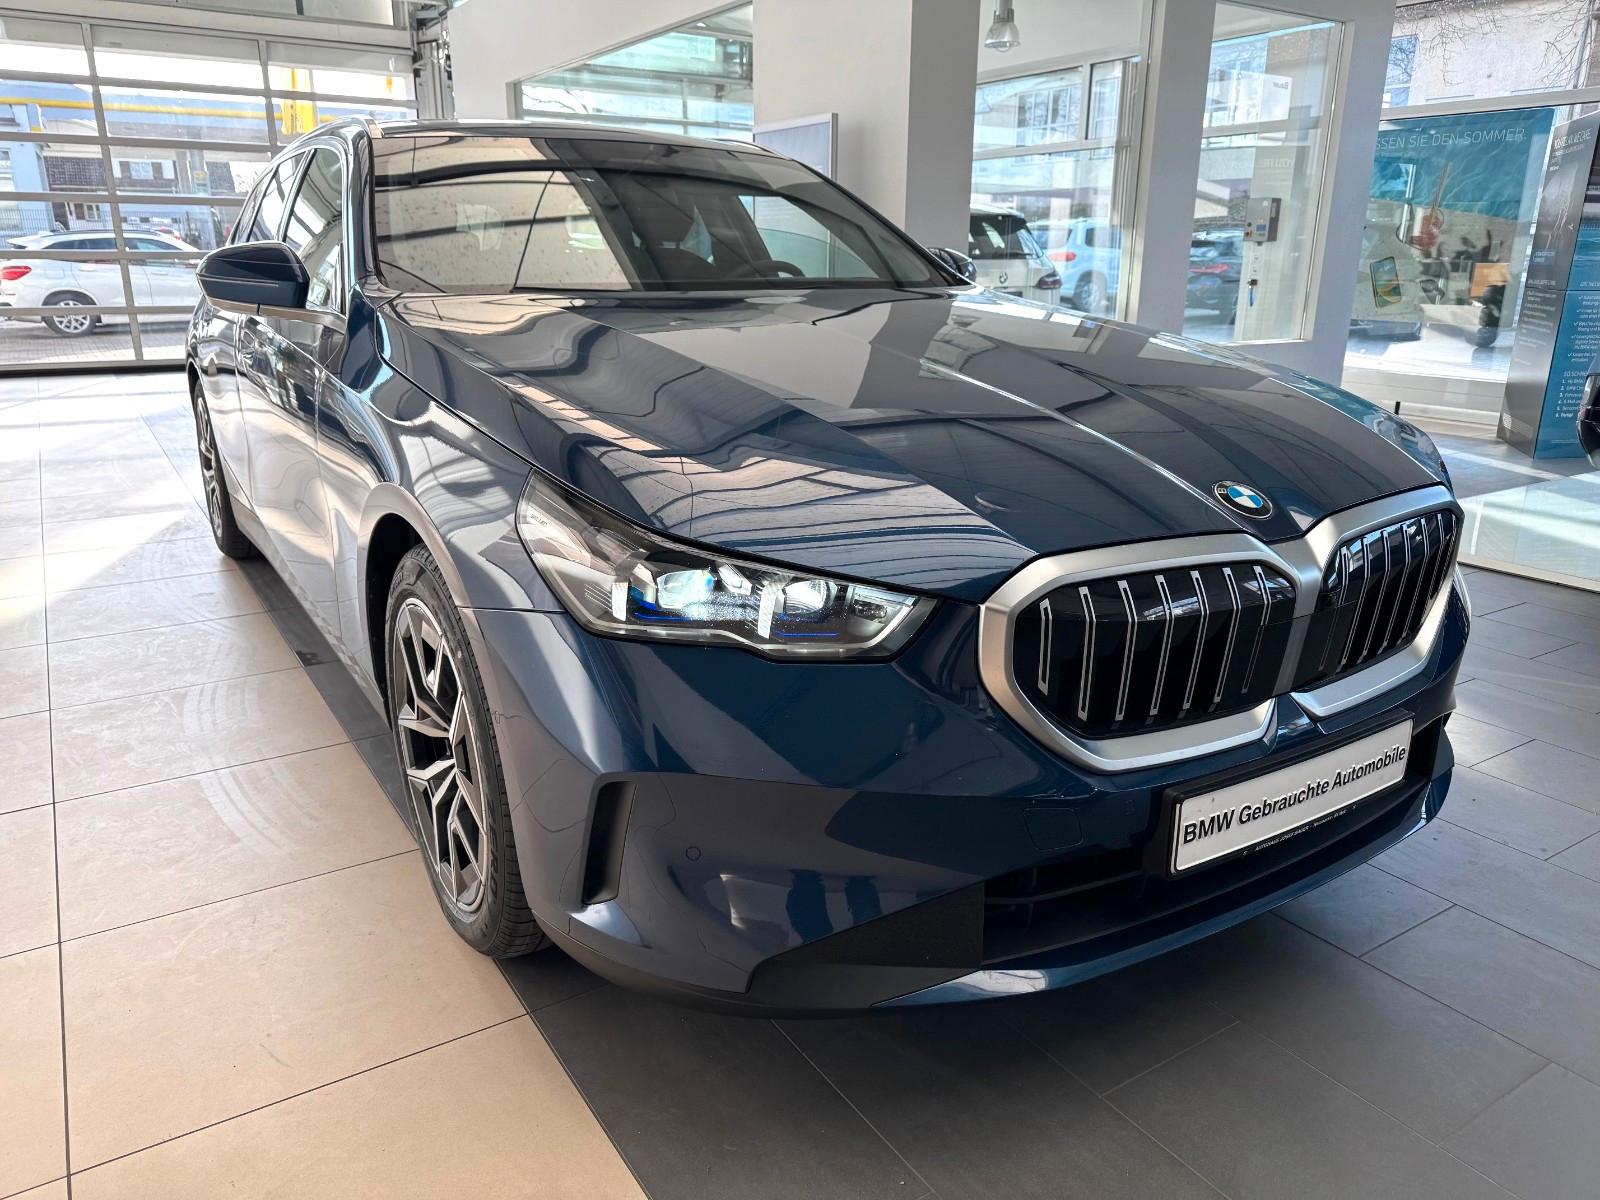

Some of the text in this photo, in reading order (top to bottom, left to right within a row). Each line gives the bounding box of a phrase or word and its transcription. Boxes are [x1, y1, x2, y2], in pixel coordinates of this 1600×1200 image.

[1409, 134, 1428, 147] SIE
[1432, 132, 1459, 146] DEN
[1183, 745, 1406, 845] BMW Gebrauchte Automobile
